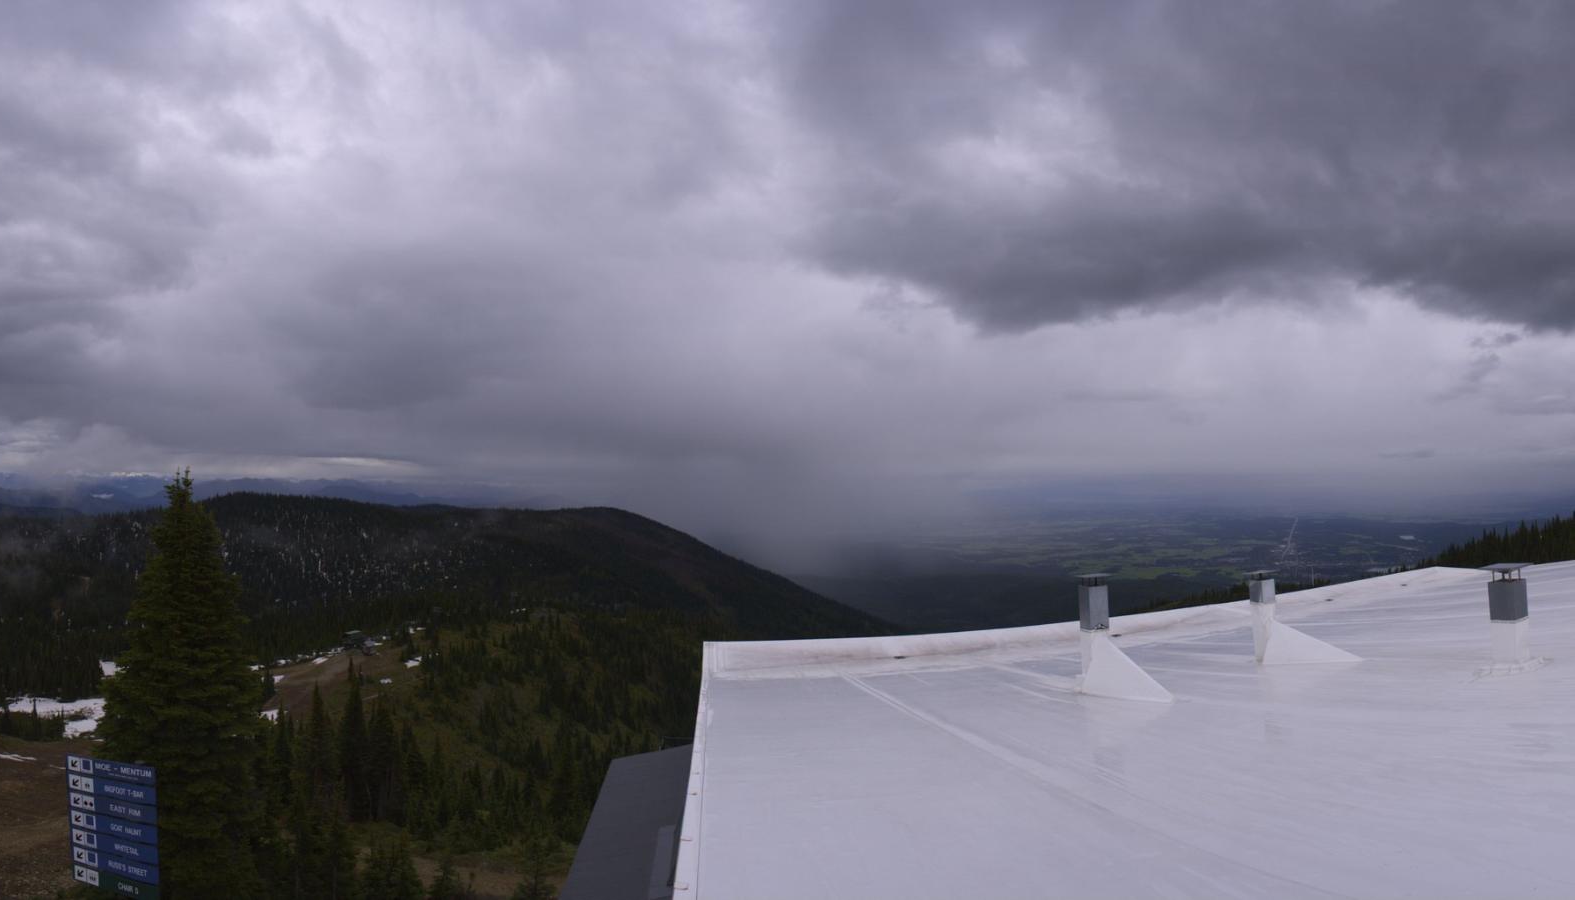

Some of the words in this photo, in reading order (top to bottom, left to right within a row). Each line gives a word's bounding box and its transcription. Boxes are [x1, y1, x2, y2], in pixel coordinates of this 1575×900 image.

[120, 766, 152, 778] MENTUM
[104, 784, 126, 796] BIGFOOT
[127, 789, 144, 799] T-BAR
[110, 803, 126, 814] EAST
[128, 808, 141, 817] RIM
[127, 866, 148, 878] STREET
